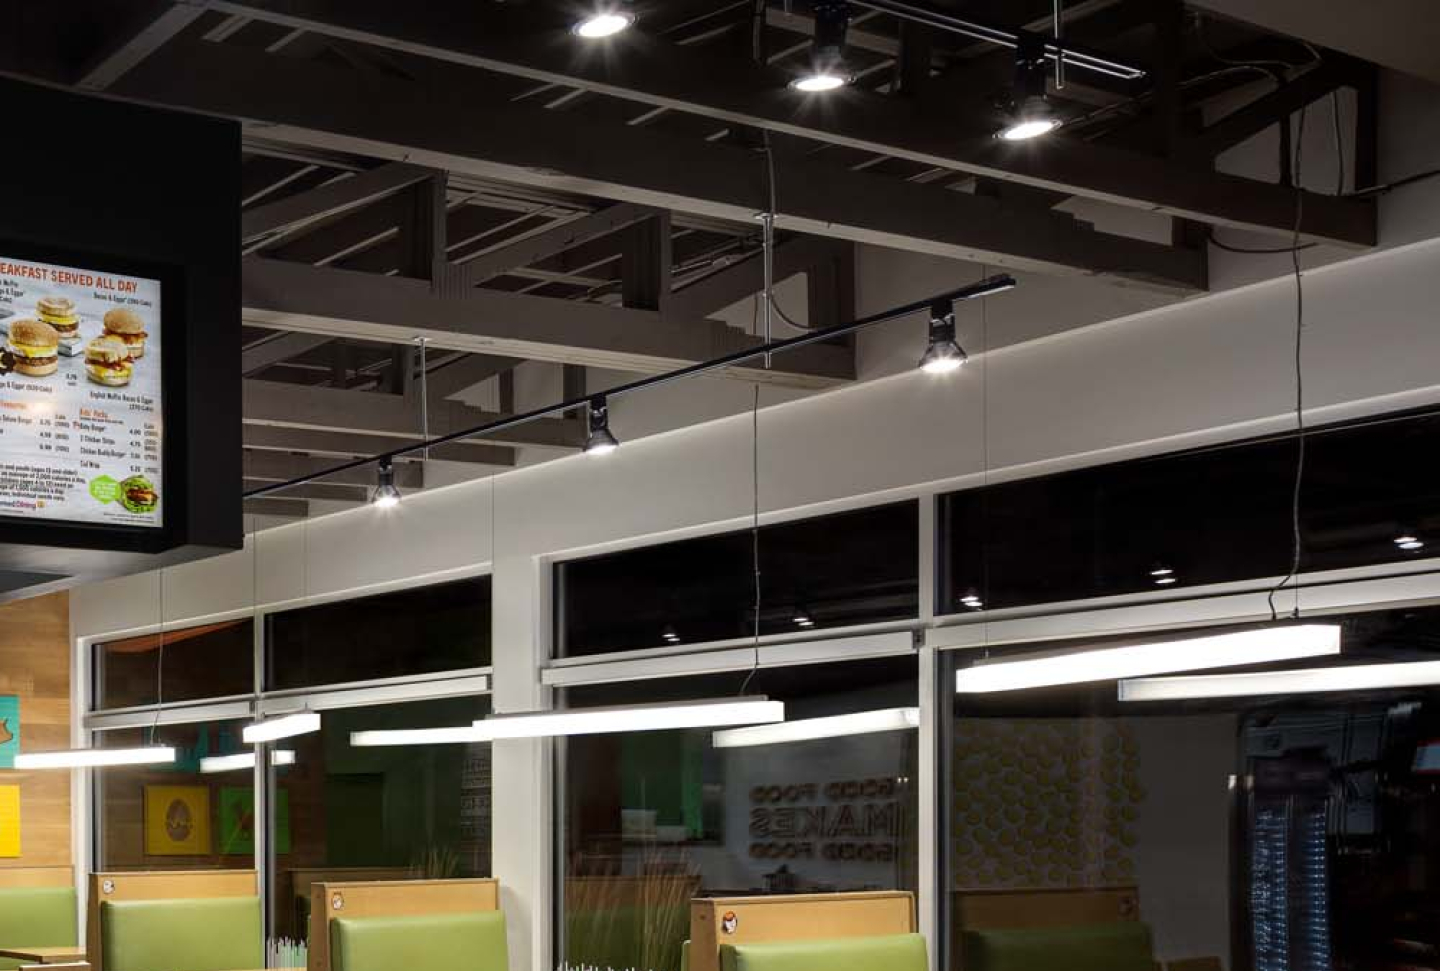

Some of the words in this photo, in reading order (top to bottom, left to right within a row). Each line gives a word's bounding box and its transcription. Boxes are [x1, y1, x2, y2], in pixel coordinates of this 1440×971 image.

[50, 269, 93, 287] SERVED
[95, 276, 116, 290] ALL
[117, 280, 138, 294] DAY
